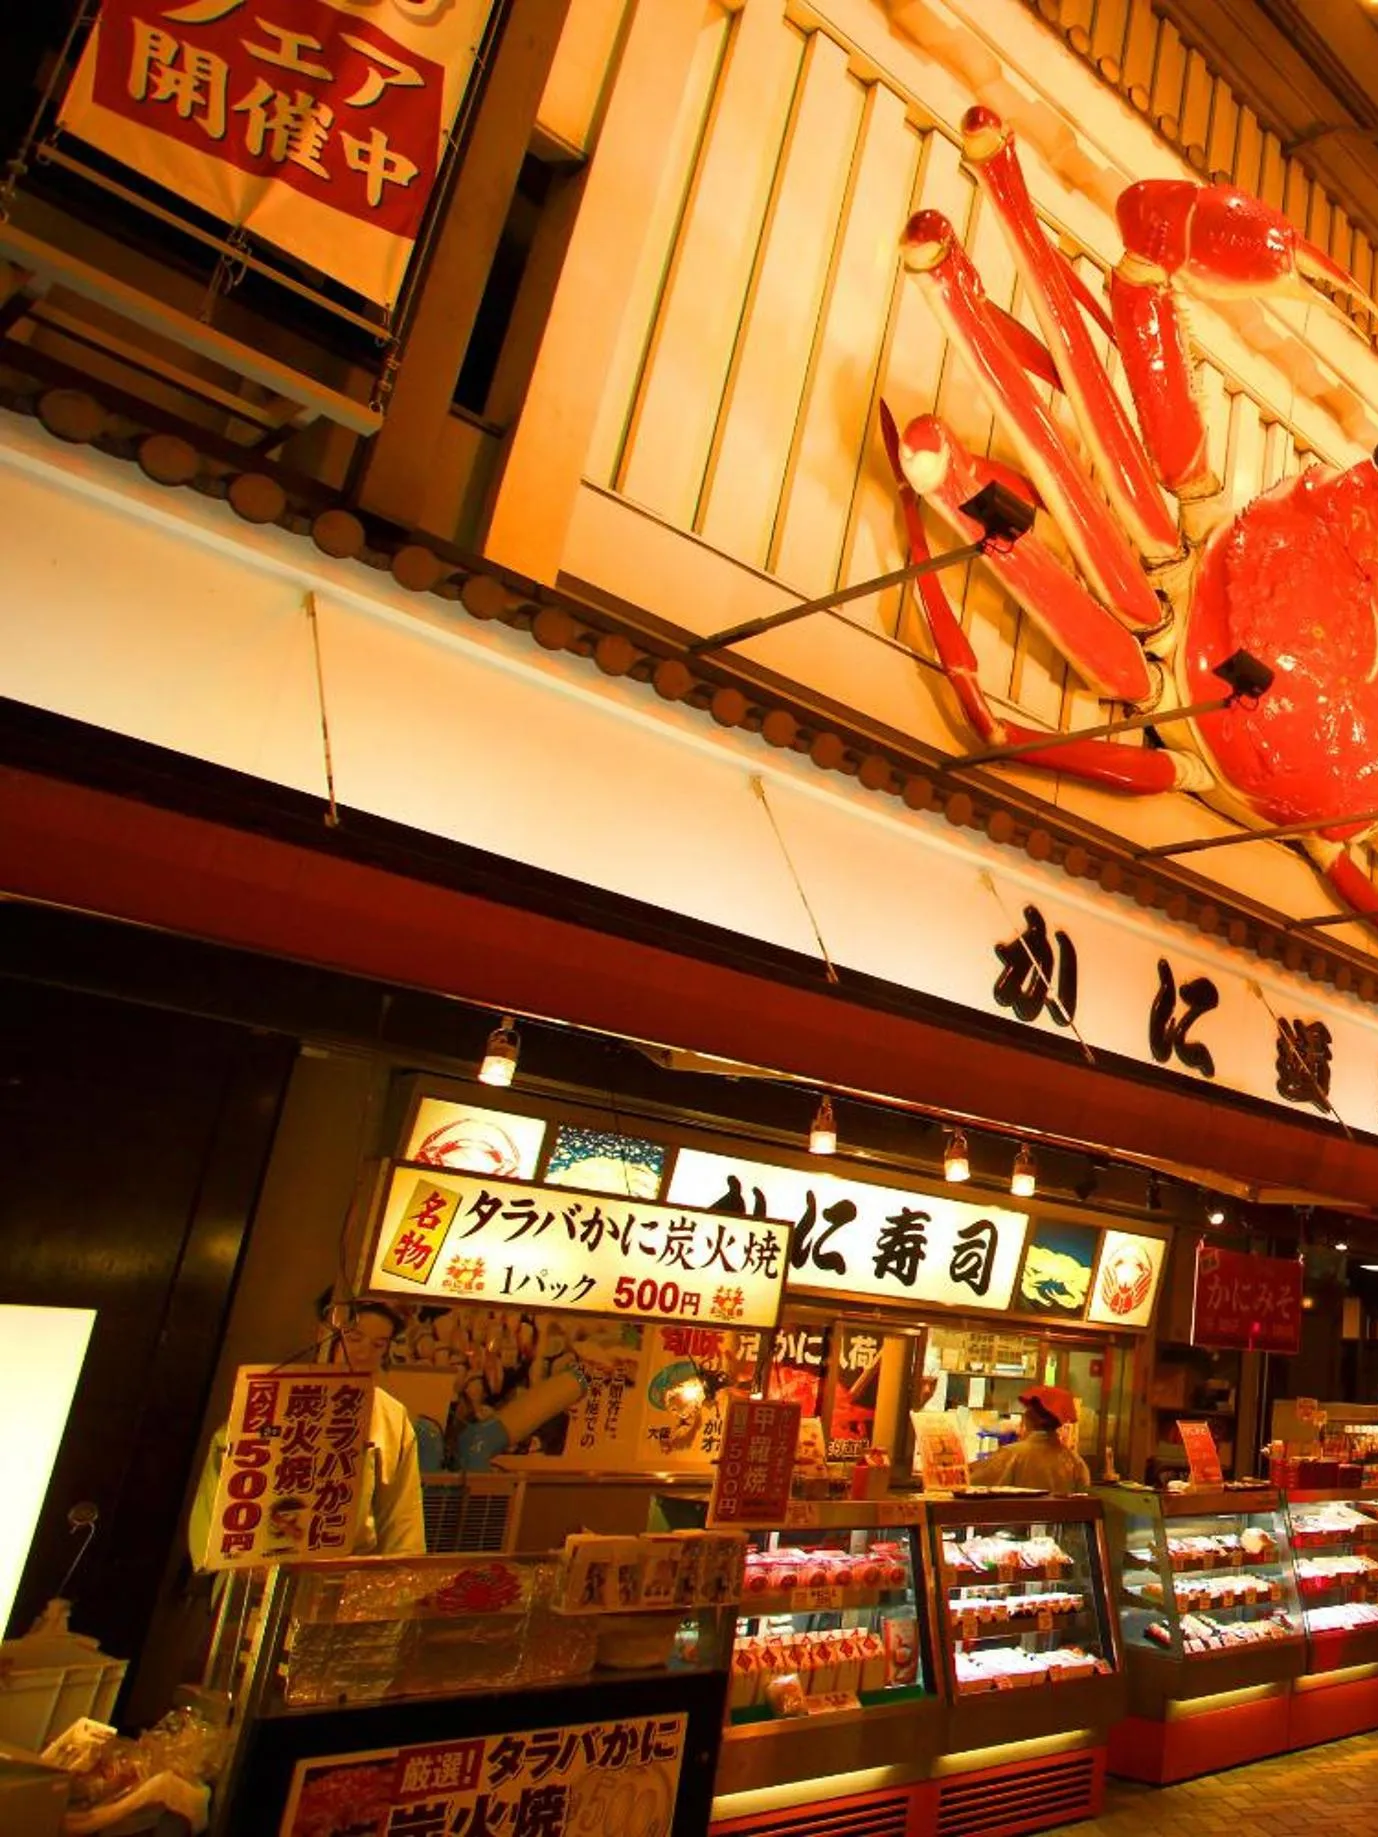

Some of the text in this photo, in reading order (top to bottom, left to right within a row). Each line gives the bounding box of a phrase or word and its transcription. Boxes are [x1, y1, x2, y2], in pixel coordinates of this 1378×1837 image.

[127, 16, 418, 208] 開催中
[394, 1190, 442, 1272] 名物
[460, 1190, 782, 1280] タラバかに炭火焼
[613, 1276, 702, 1317] 500円
[219, 1438, 271, 1554] 500円
[272, 1384, 365, 1552] タラバかに 炭火焼
[486, 1720, 681, 1790] タラバかに
